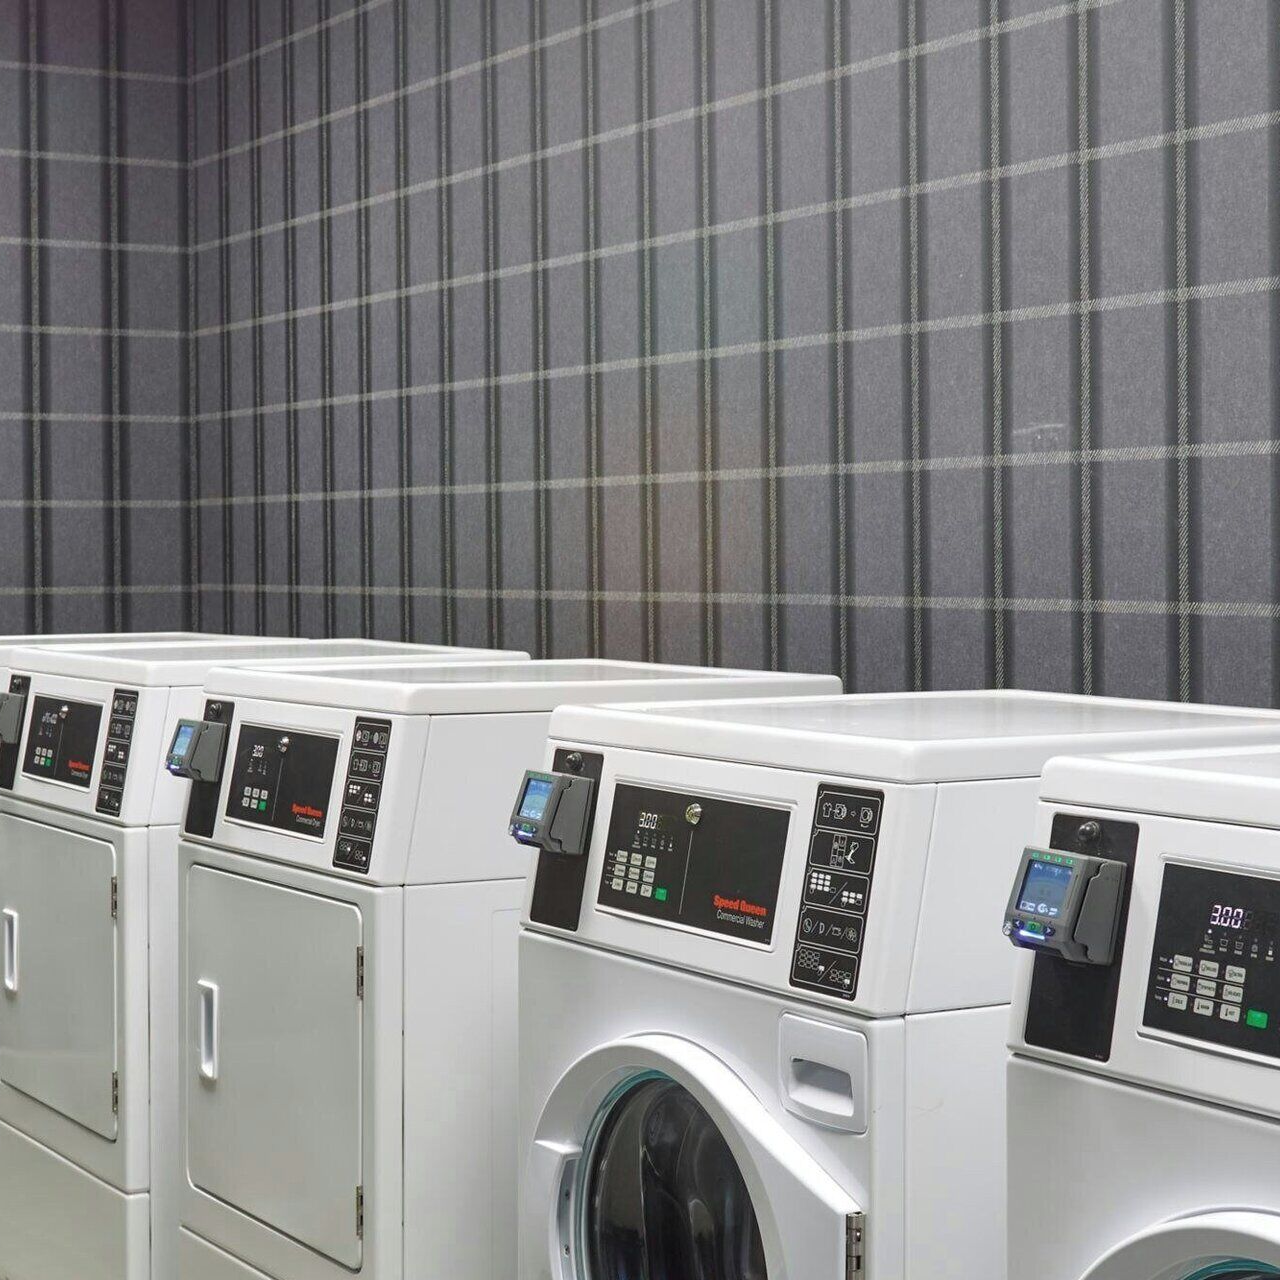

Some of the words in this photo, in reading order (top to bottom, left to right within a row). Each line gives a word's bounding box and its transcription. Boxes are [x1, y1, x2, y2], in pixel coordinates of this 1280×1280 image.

[713, 894, 740, 910] Speed
[740, 900, 767, 916] Queen
[716, 909, 745, 924] Commercial
[746, 916, 765, 928] Washer
[1210, 904, 1244, 929] 3.00
